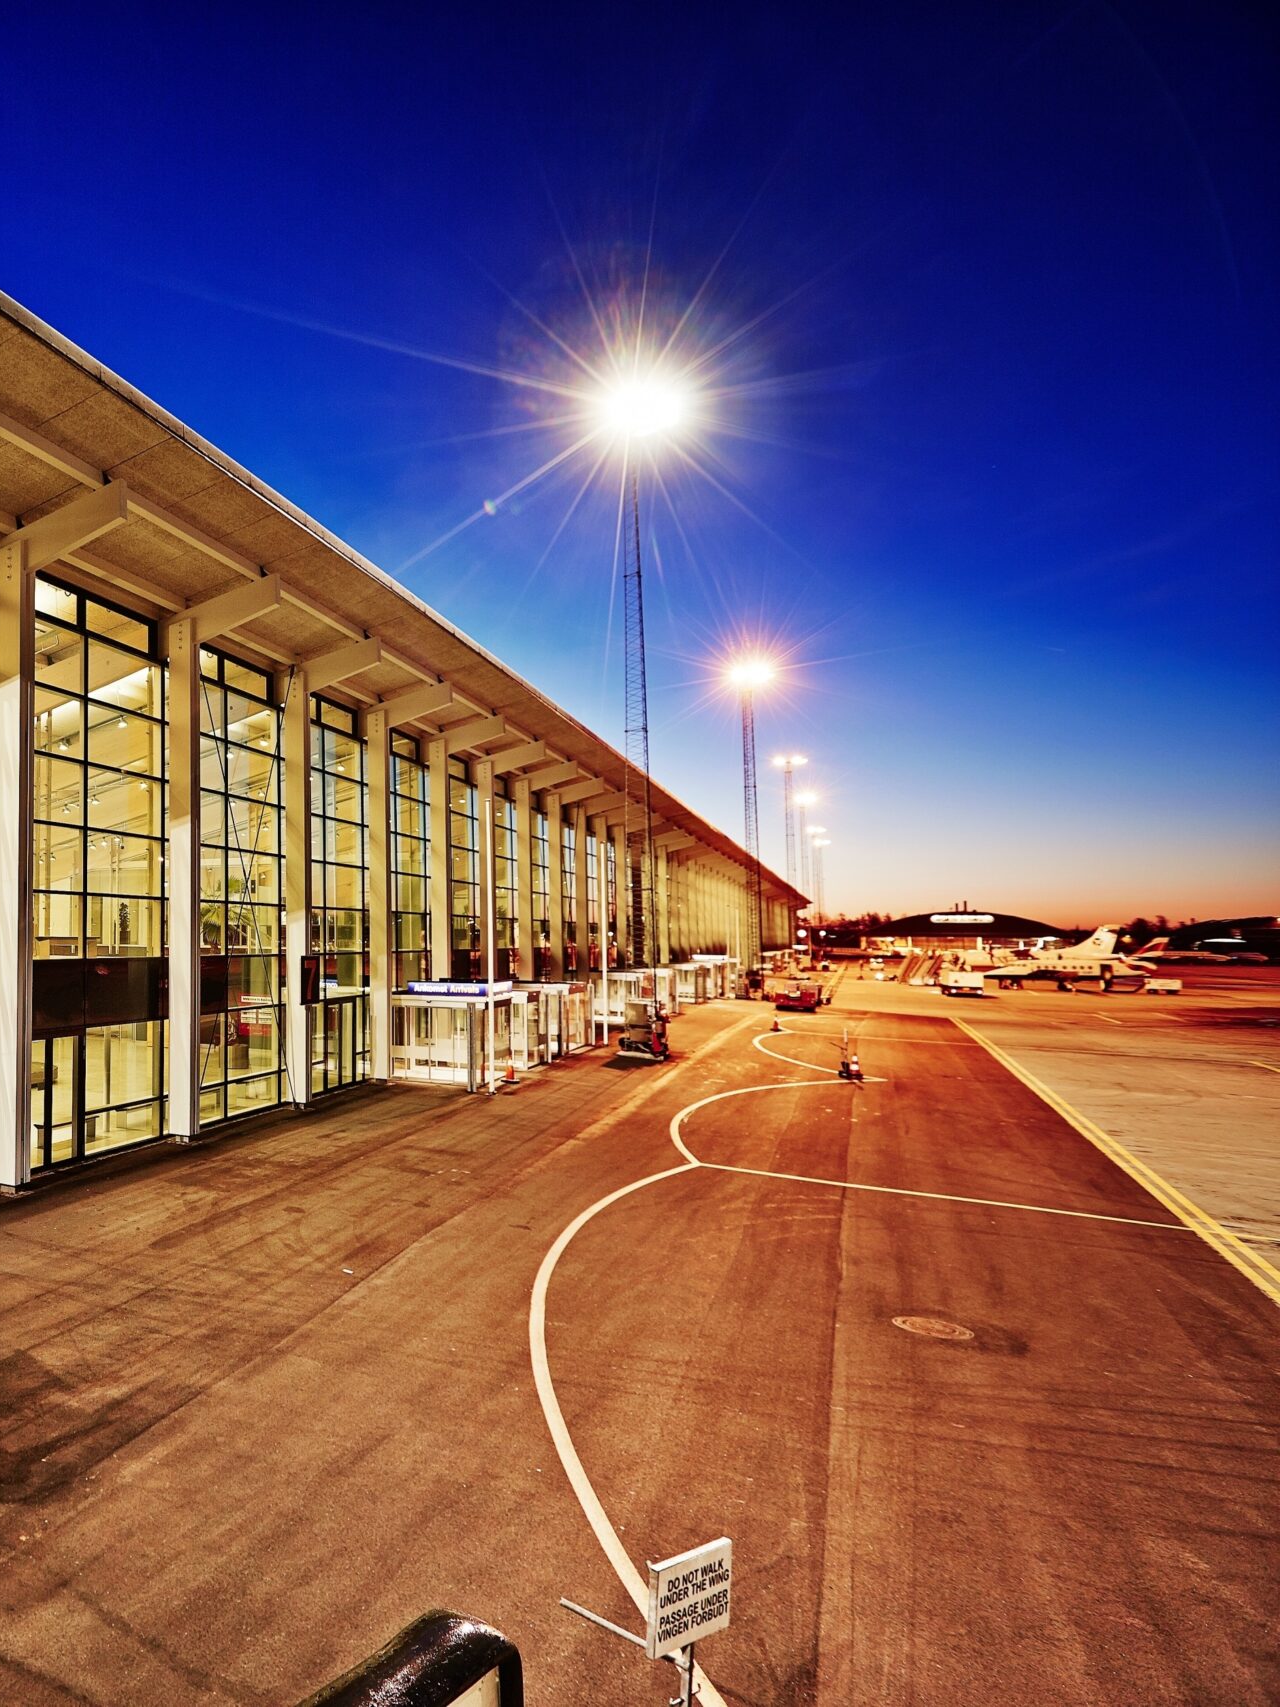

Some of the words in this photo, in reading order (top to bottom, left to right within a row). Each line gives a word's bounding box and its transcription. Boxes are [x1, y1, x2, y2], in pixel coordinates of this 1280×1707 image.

[304, 960, 317, 1000] 7
[449, 984, 480, 994] Arrivals
[660, 1586, 689, 1609] UNDER
[691, 1579, 707, 1596] THE
[708, 1568, 730, 1588] WING
[667, 1577, 681, 1593] DO
[682, 1568, 699, 1587] NOT
[700, 1558, 724, 1578] WALK
[657, 1619, 689, 1643] VINGEN
[690, 1601, 729, 1628] FORBUDT
[659, 1601, 699, 1629] PASSAGE
[700, 1588, 728, 1611] UNDER
